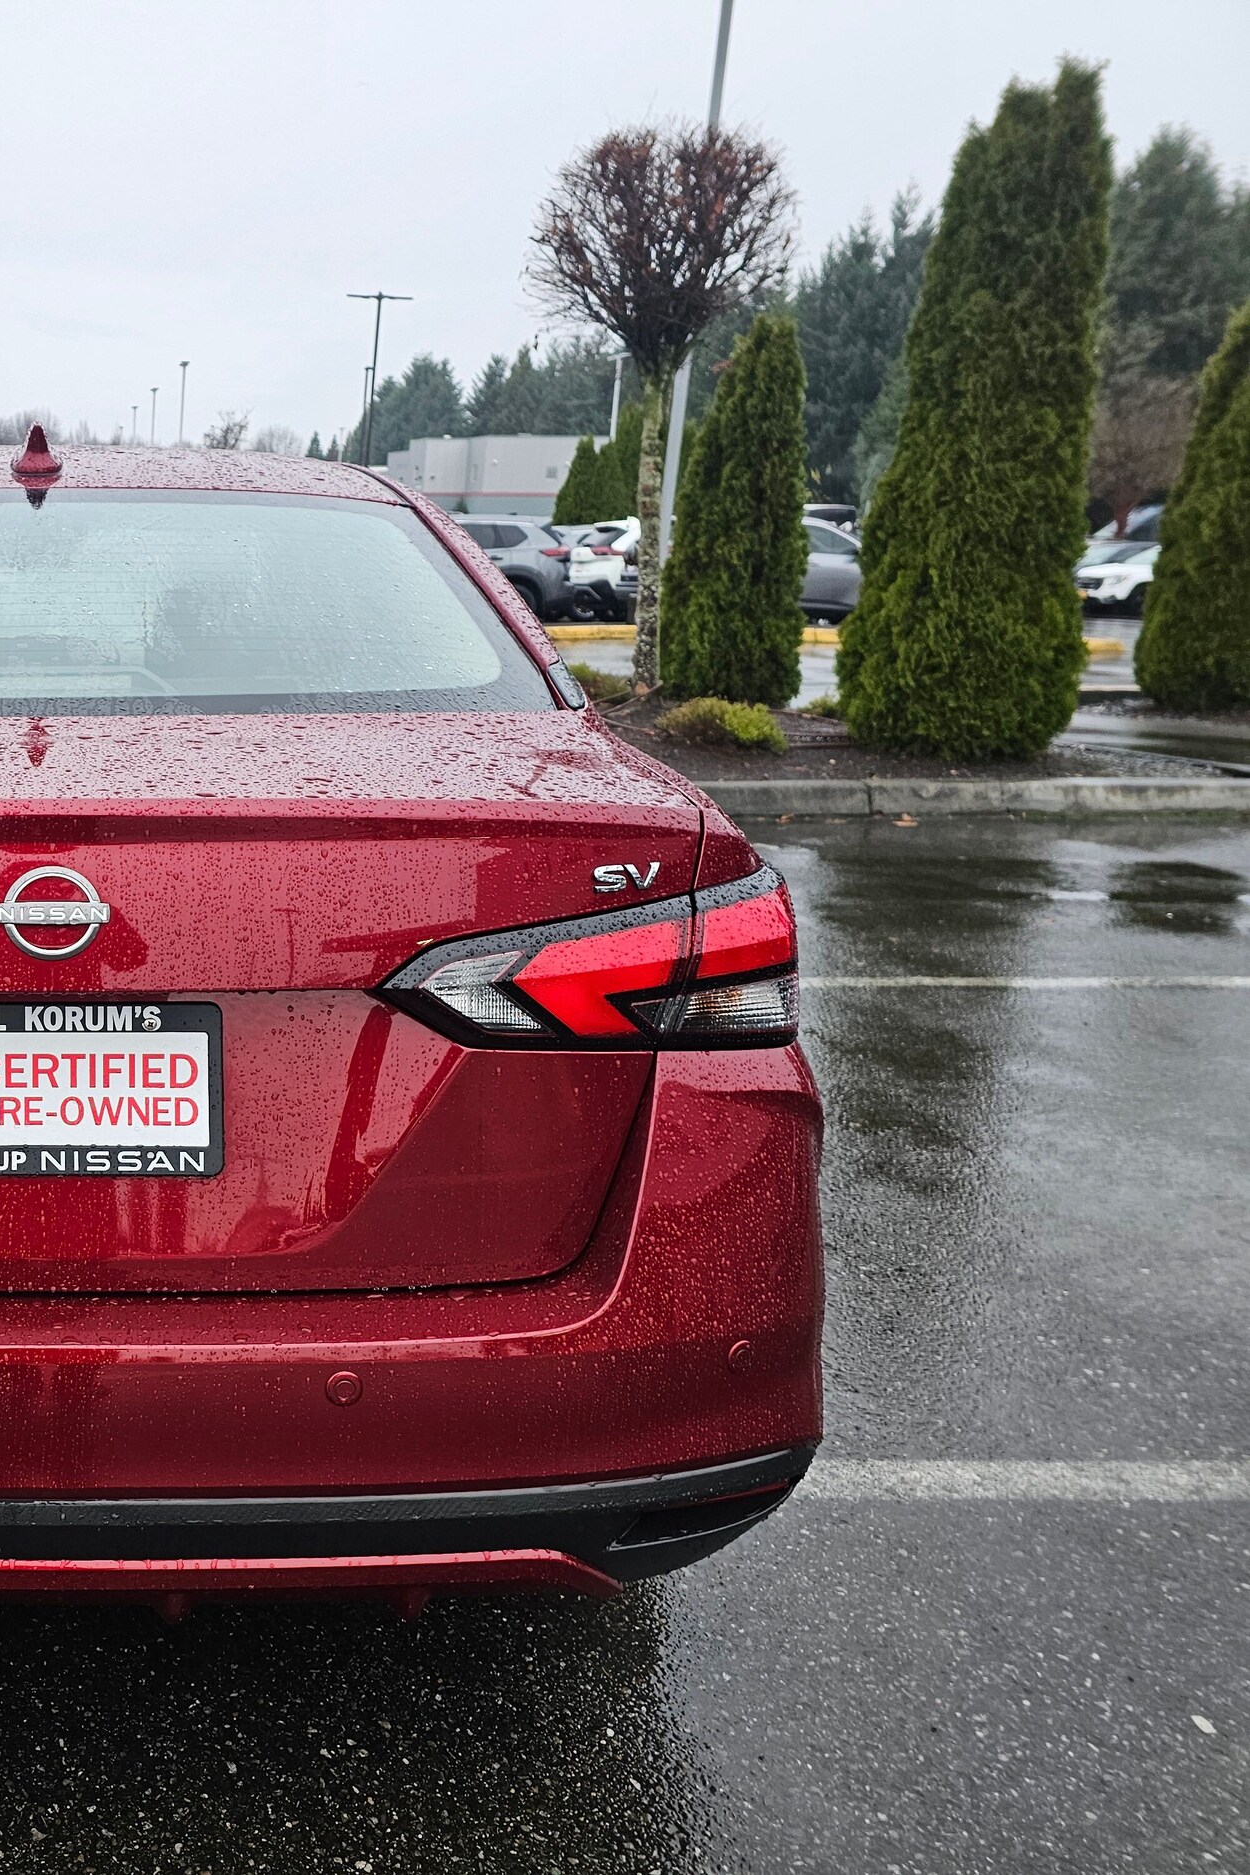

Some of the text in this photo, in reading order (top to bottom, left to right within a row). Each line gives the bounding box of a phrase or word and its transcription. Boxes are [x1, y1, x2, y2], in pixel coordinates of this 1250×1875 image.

[593, 861, 660, 892] SV
[24, 1006, 162, 1032] KORUM'S
[41, 1151, 205, 1172] NISSAN
